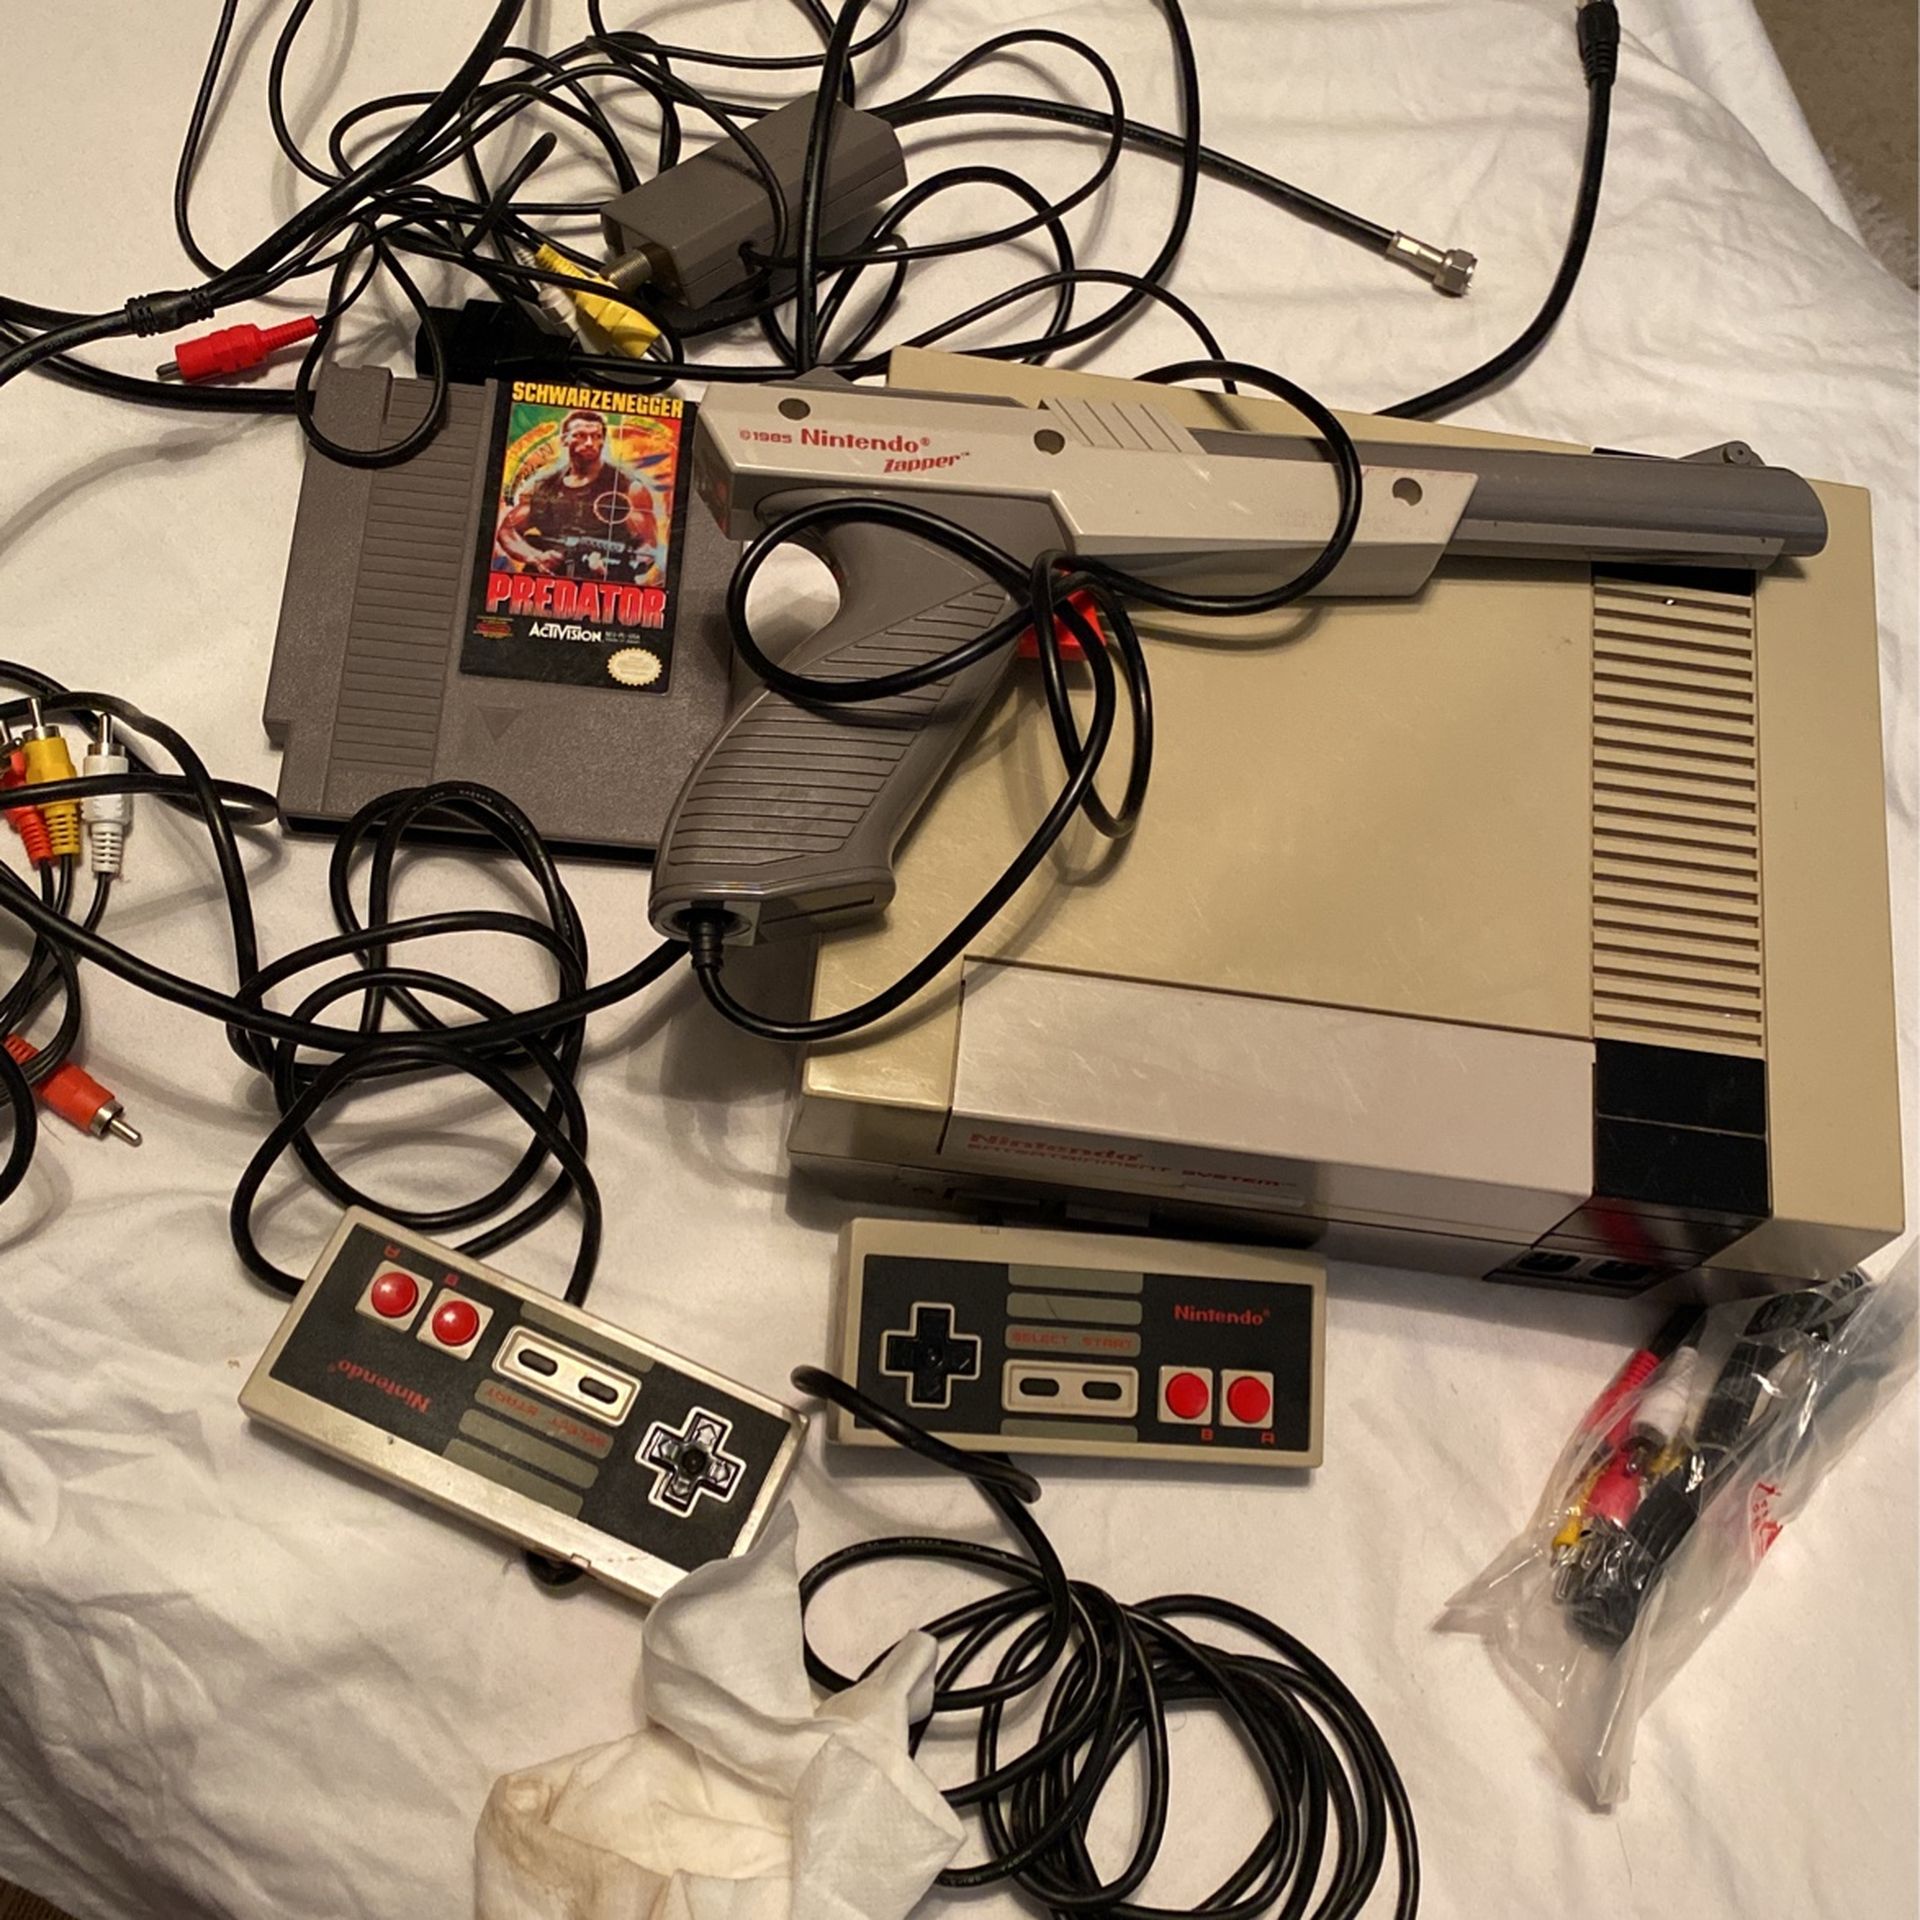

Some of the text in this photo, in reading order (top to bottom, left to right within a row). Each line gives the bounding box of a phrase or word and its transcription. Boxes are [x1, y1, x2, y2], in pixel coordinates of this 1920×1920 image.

[512, 381, 684, 418] SCHWARZENEGGER
[486, 572, 667, 630] PREDATOR
[1200, 1427, 1214, 1442] B
[1260, 1431, 1276, 1445] A
